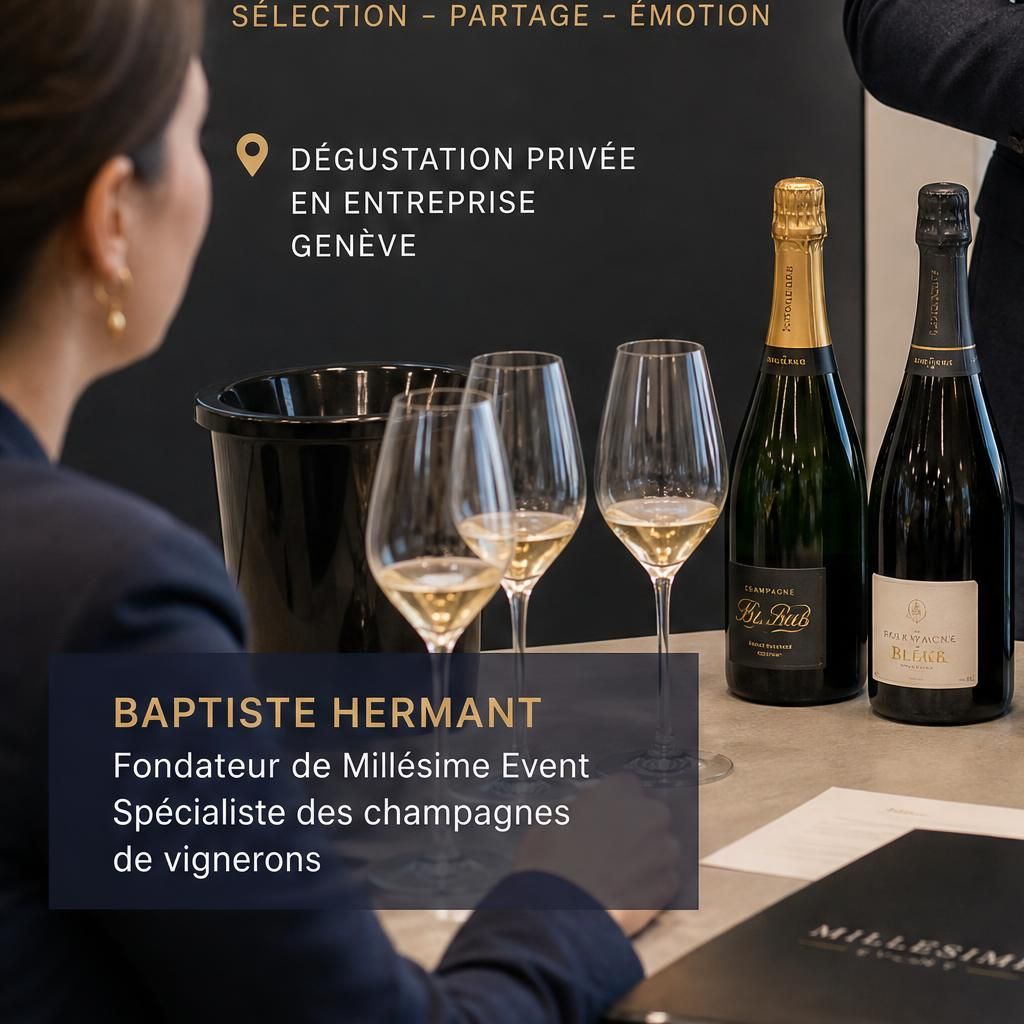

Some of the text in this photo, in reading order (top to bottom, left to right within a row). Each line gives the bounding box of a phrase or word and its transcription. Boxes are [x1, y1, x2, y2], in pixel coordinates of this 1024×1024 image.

[450, 3, 589, 27] PARTAGE
[292, 141, 636, 172] DÉGUSTATION PRIVÉE
[292, 191, 535, 215] EN ENTREPRISE
[292, 229, 416, 258] GENÈVE
